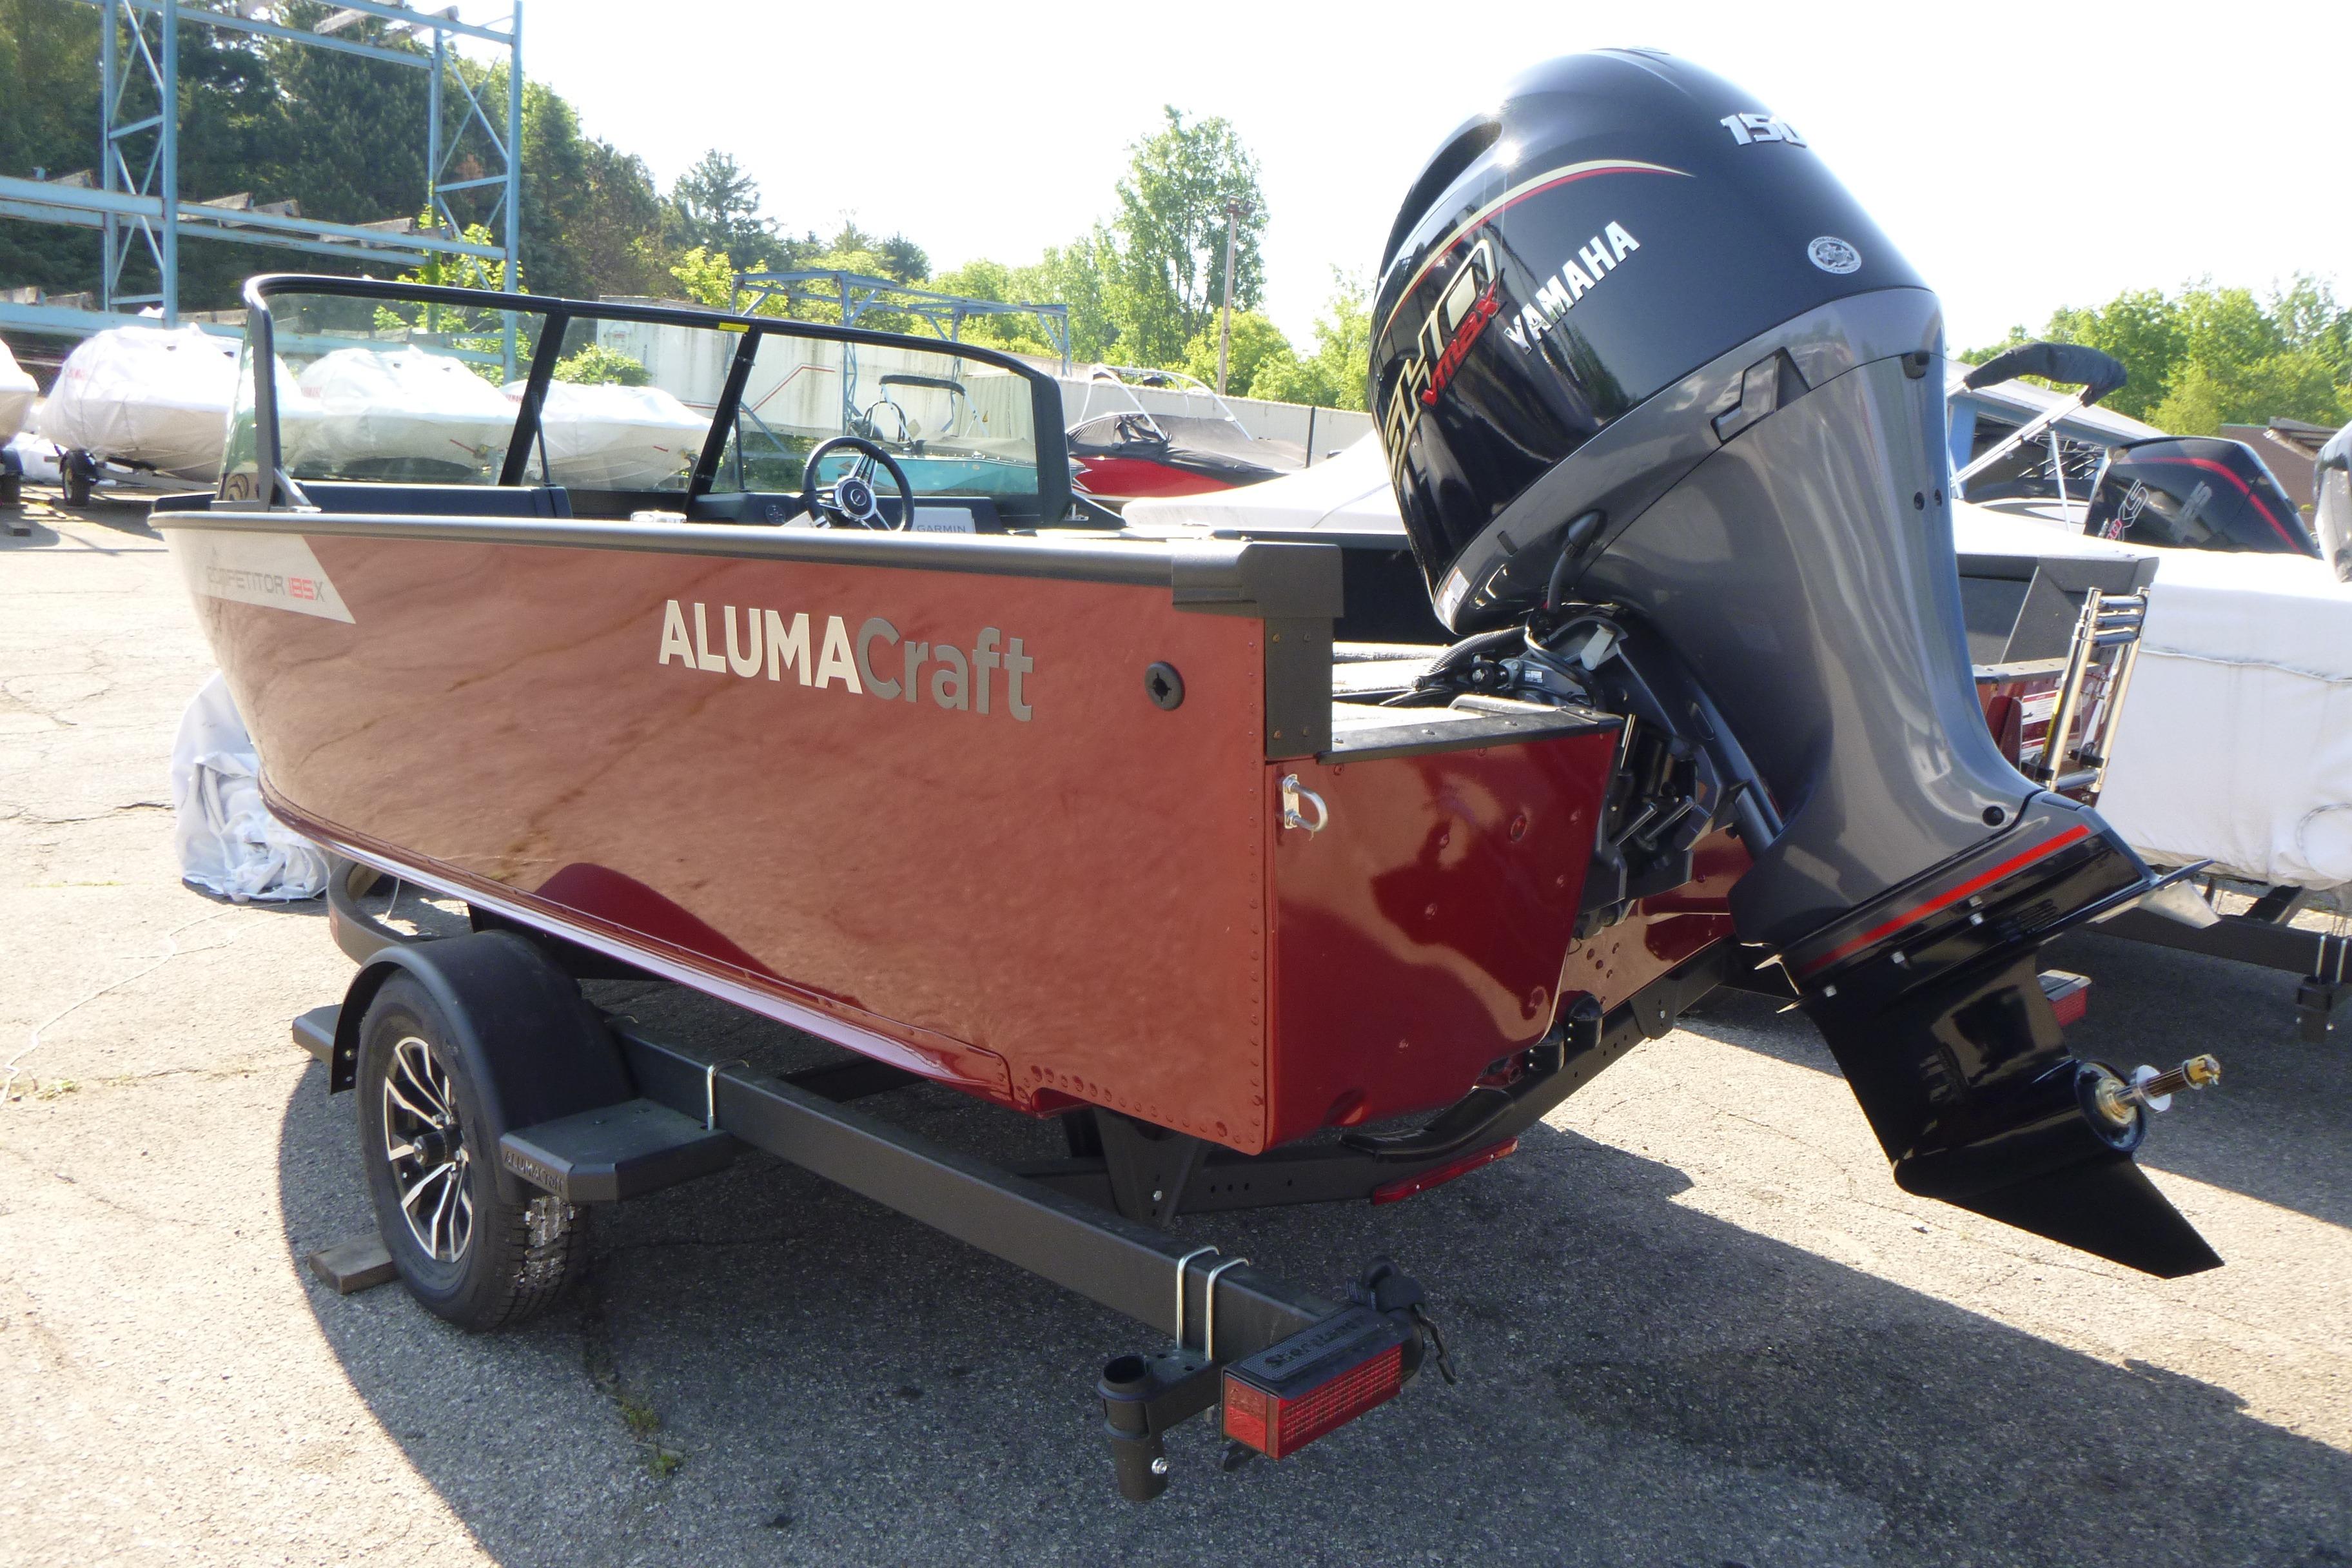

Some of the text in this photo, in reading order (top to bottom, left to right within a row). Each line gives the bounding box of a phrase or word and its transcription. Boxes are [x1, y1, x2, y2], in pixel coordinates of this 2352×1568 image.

[1720, 112, 1807, 148] 150
[1504, 221, 1640, 355] YAMAHA
[917, 525, 966, 533] GARMIN
[658, 599, 1034, 721] ALUMACraft
